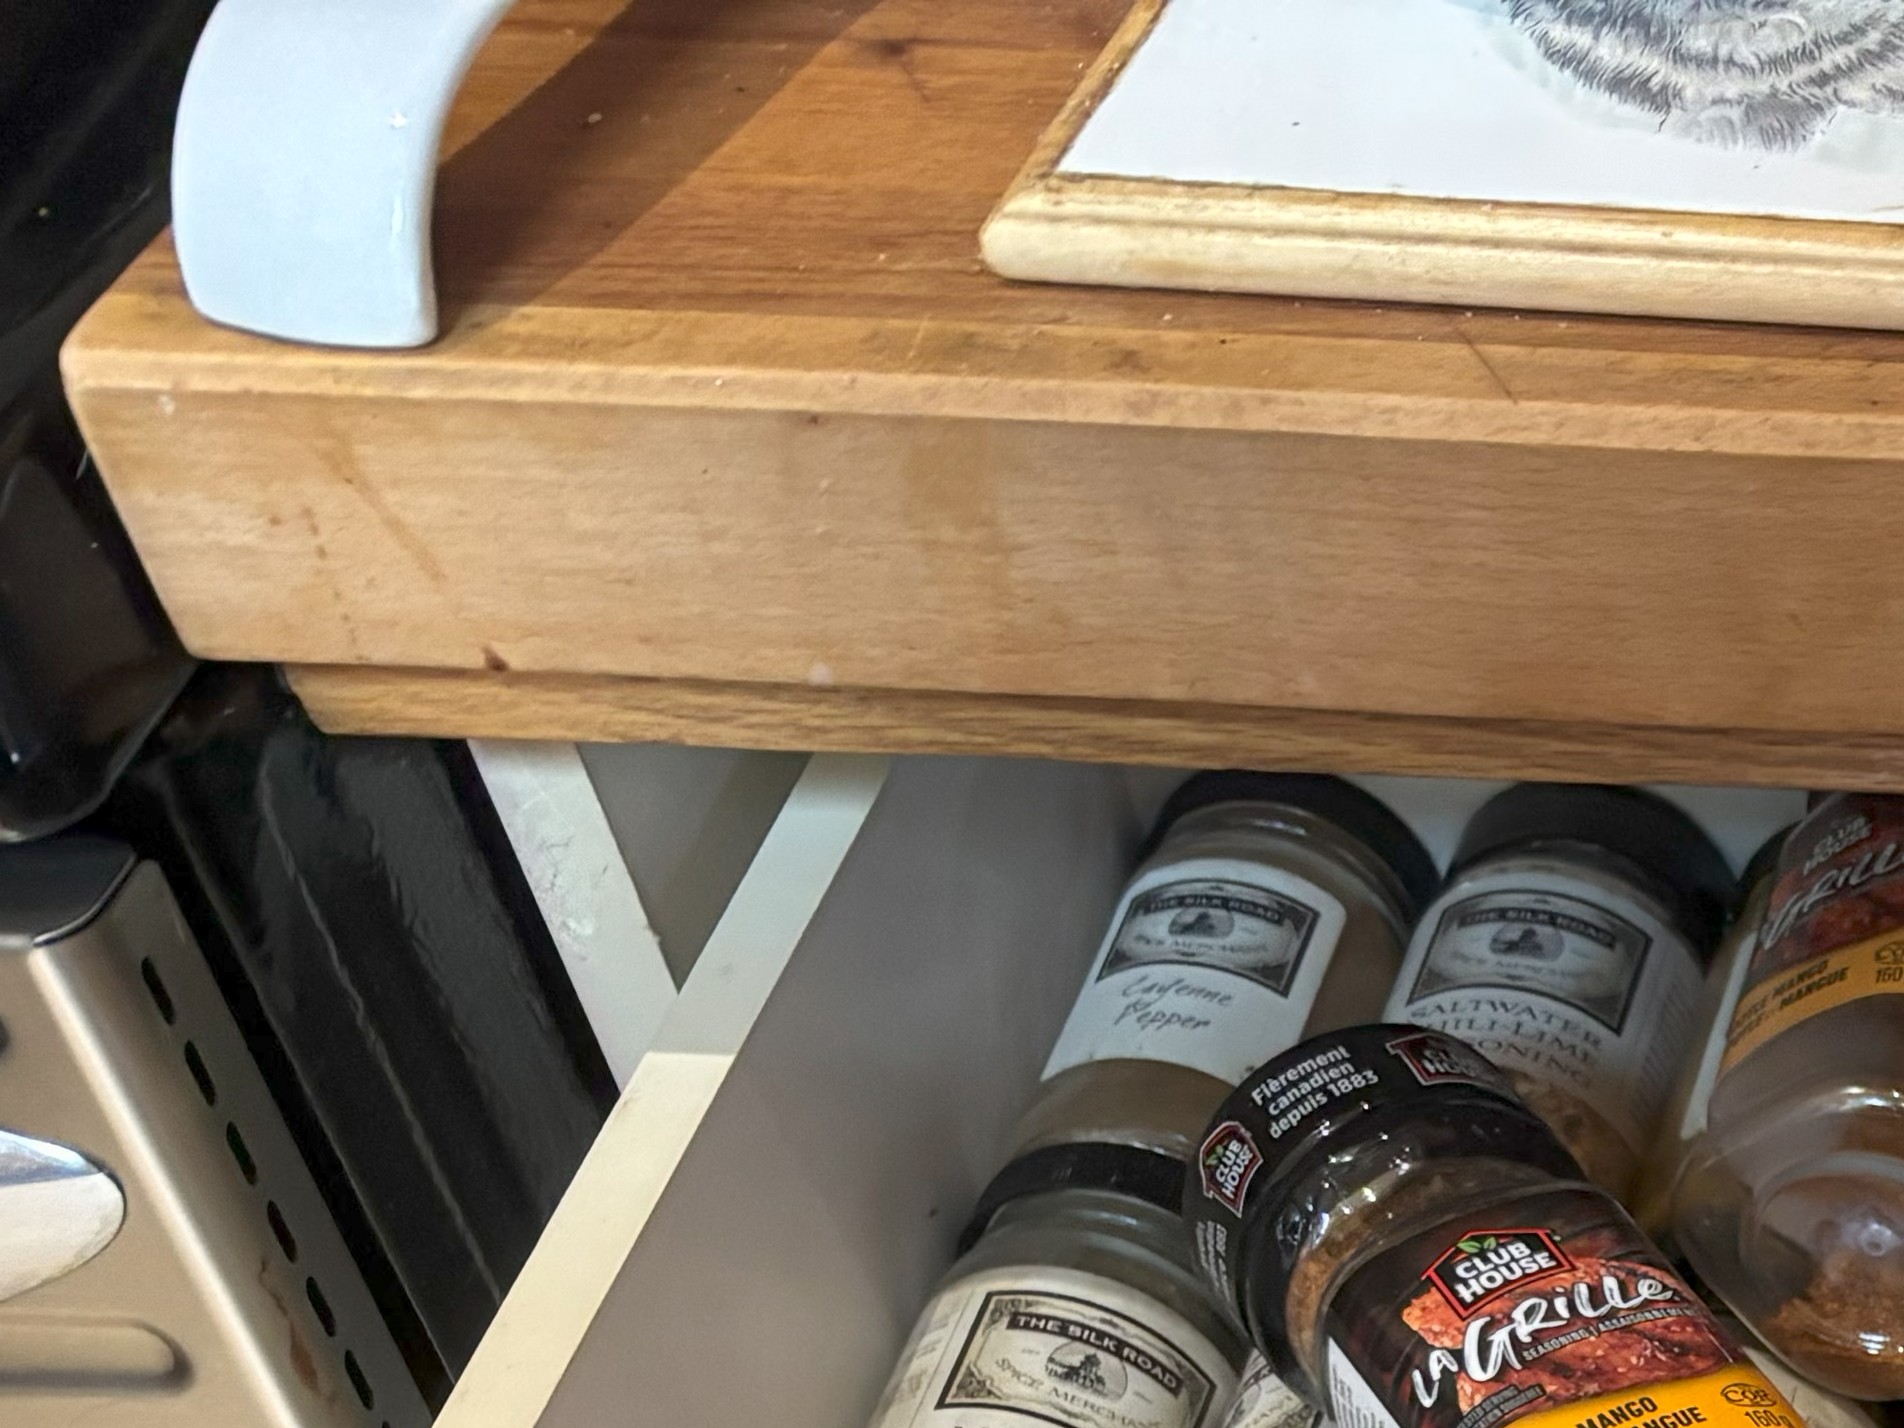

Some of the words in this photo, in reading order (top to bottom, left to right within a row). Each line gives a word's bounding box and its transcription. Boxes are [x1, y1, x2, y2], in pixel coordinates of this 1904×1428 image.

[1114, 1000, 1212, 1031] Pepper
[1251, 1044, 1351, 1106] Fièrement
[1267, 1060, 1356, 1116] canadien
[1268, 1091, 1328, 1139] depuis
[1454, 1239, 1533, 1279] CLUB
[1454, 1252, 1558, 1303] HOUSE
[1067, 1324, 1119, 1352] SILK
[1122, 1346, 1178, 1390] ROAD
[1411, 1348, 1459, 1408] LA
